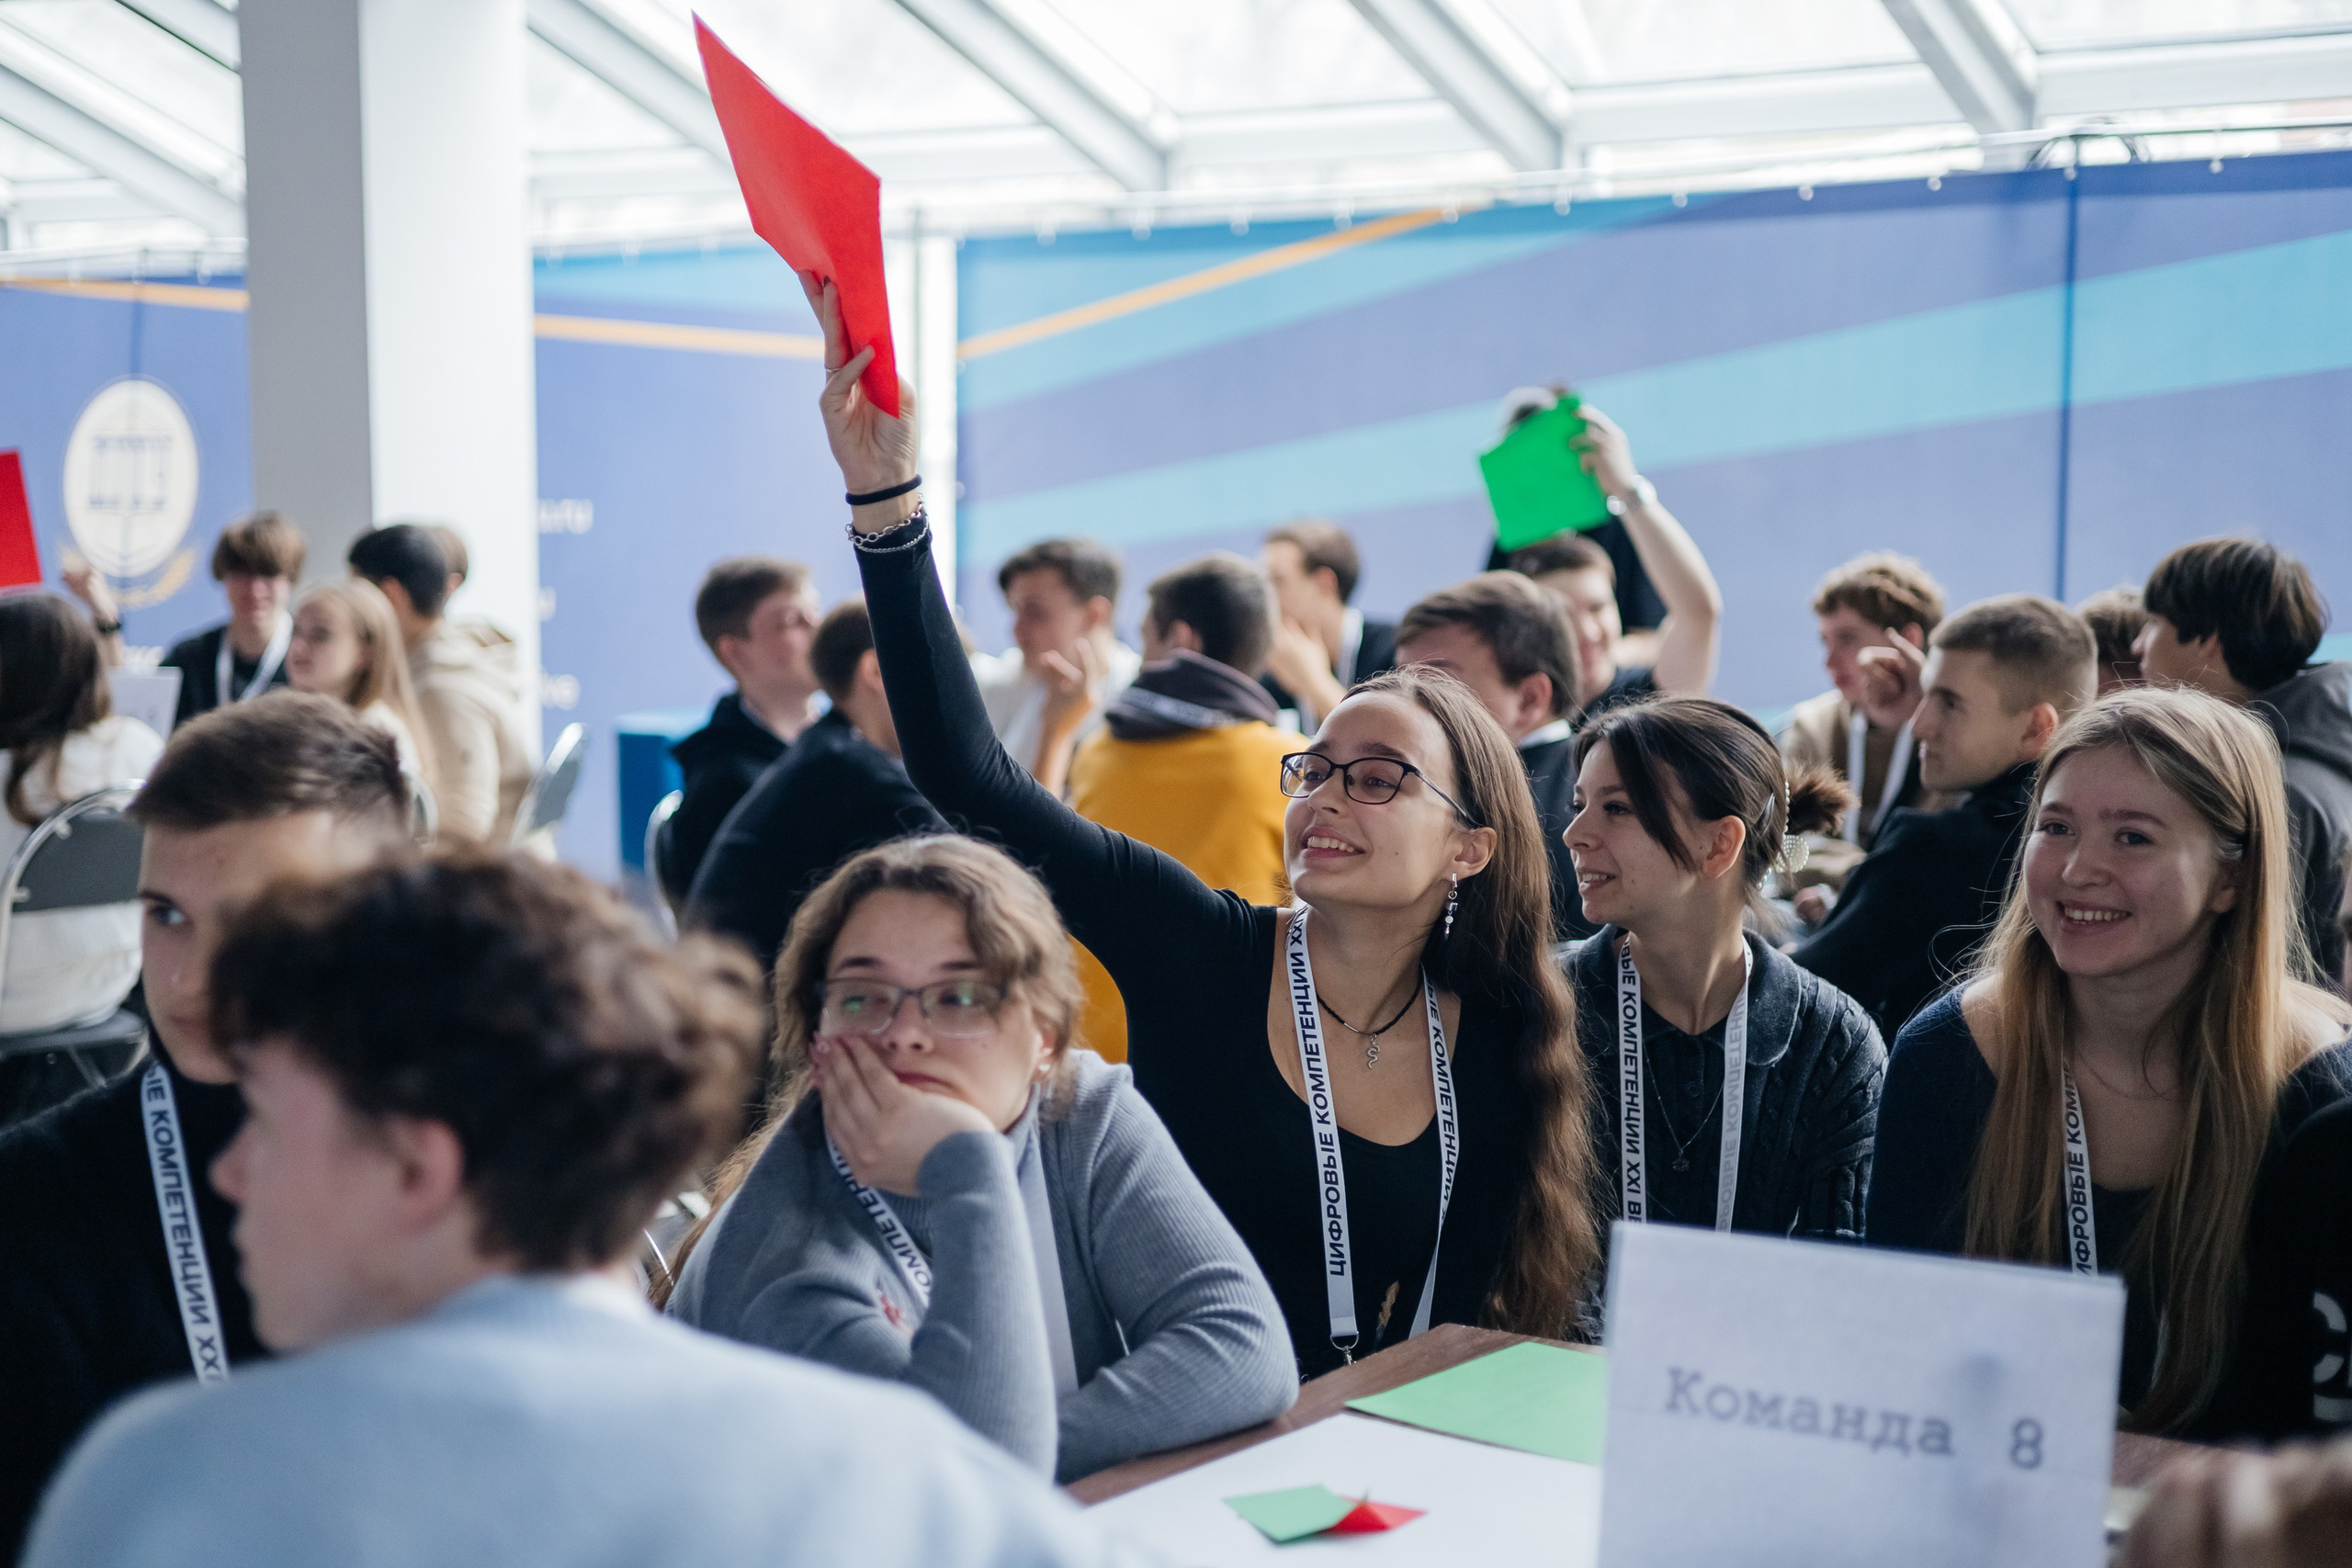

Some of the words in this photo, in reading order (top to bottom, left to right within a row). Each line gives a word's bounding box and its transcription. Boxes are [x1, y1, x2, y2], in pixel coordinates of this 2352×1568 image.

[1289, 951, 1331, 1125] КОМПЕТЕНЦИИ
[1620, 942, 1636, 987] ВЫЕ
[1431, 1025, 1457, 1201] КОМПЕТЕНЦИИ
[1622, 990, 1641, 1156] КОМПЕТЕНЦИИ
[150, 1109, 211, 1325] КОМПЕТЕНЦИИ
[1318, 1131, 1347, 1277] ЦИФРОВЫЕ
[1664, 1366, 1956, 1458] Команда
[2007, 1416, 2045, 1472] 8
